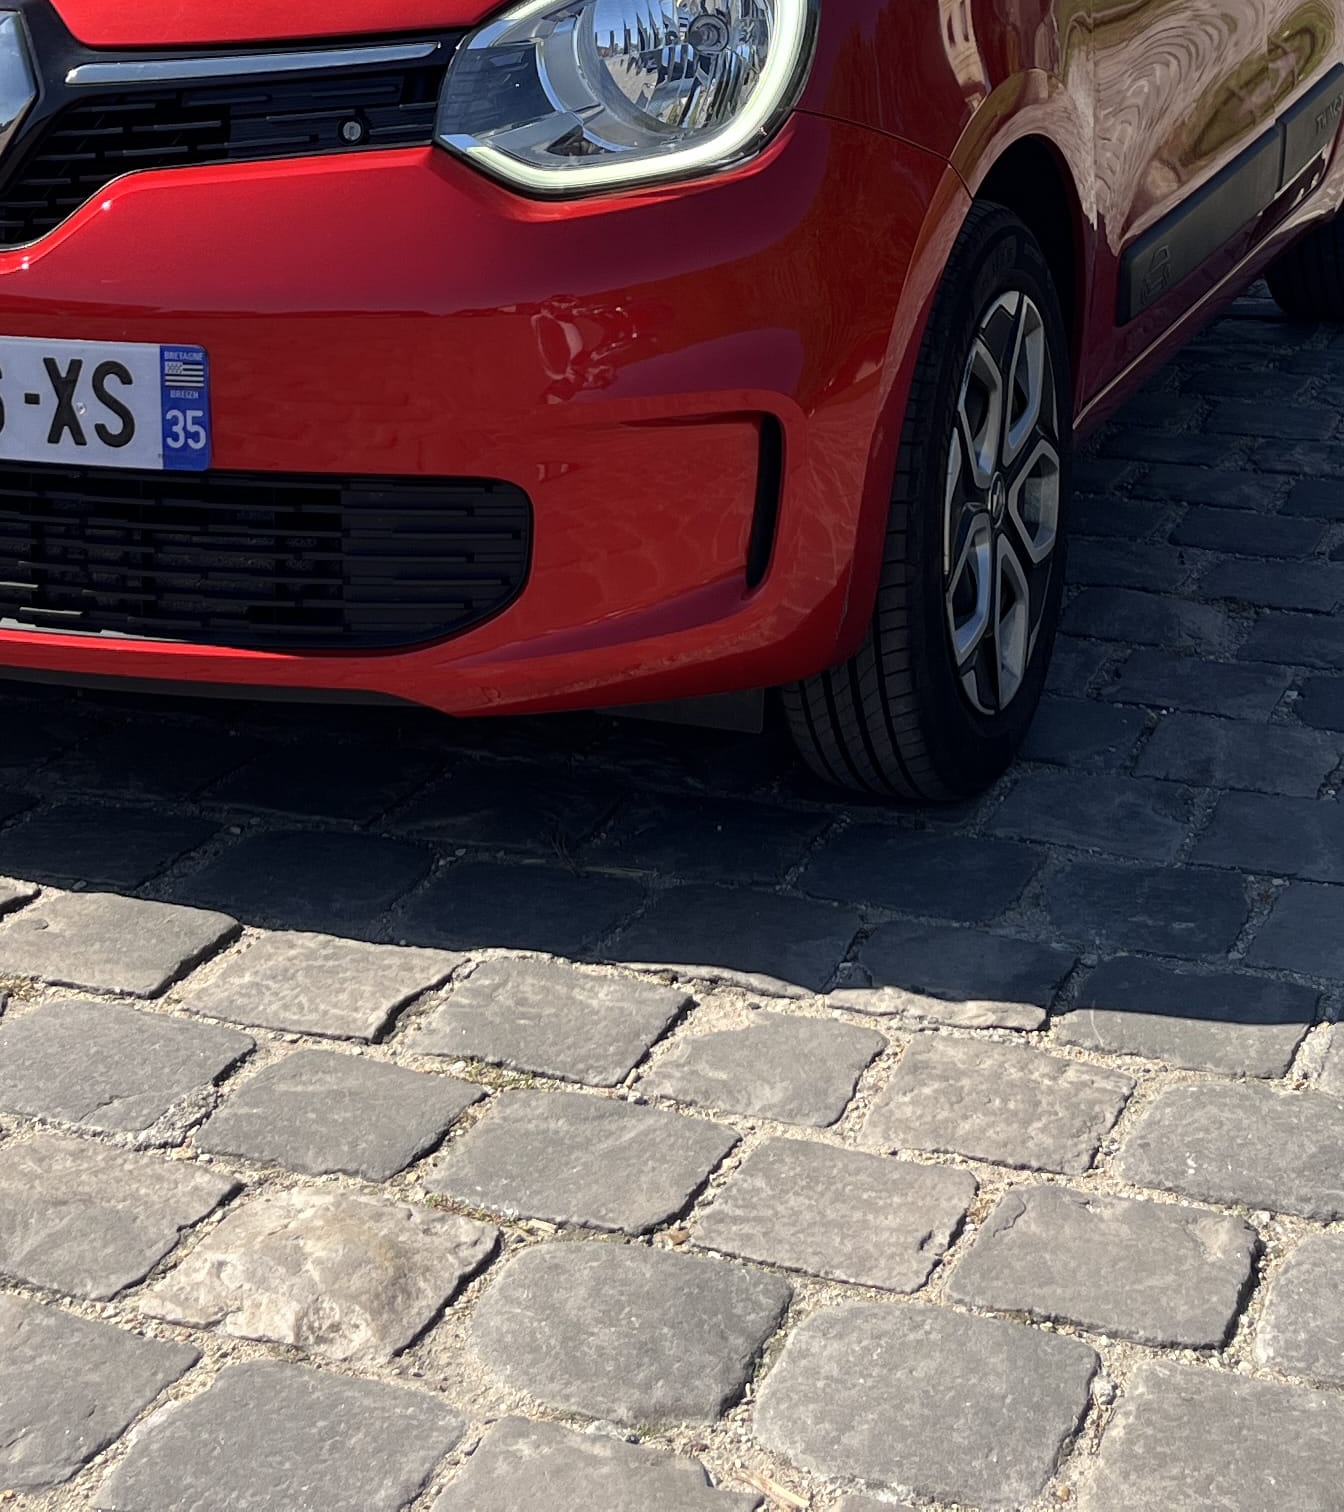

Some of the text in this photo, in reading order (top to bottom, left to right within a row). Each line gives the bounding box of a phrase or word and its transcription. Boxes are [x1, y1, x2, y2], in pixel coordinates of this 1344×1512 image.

[164, 351, 203, 361] BRETAGNE
[170, 389, 199, 399] BREIZH
[166, 409, 206, 450] 35
